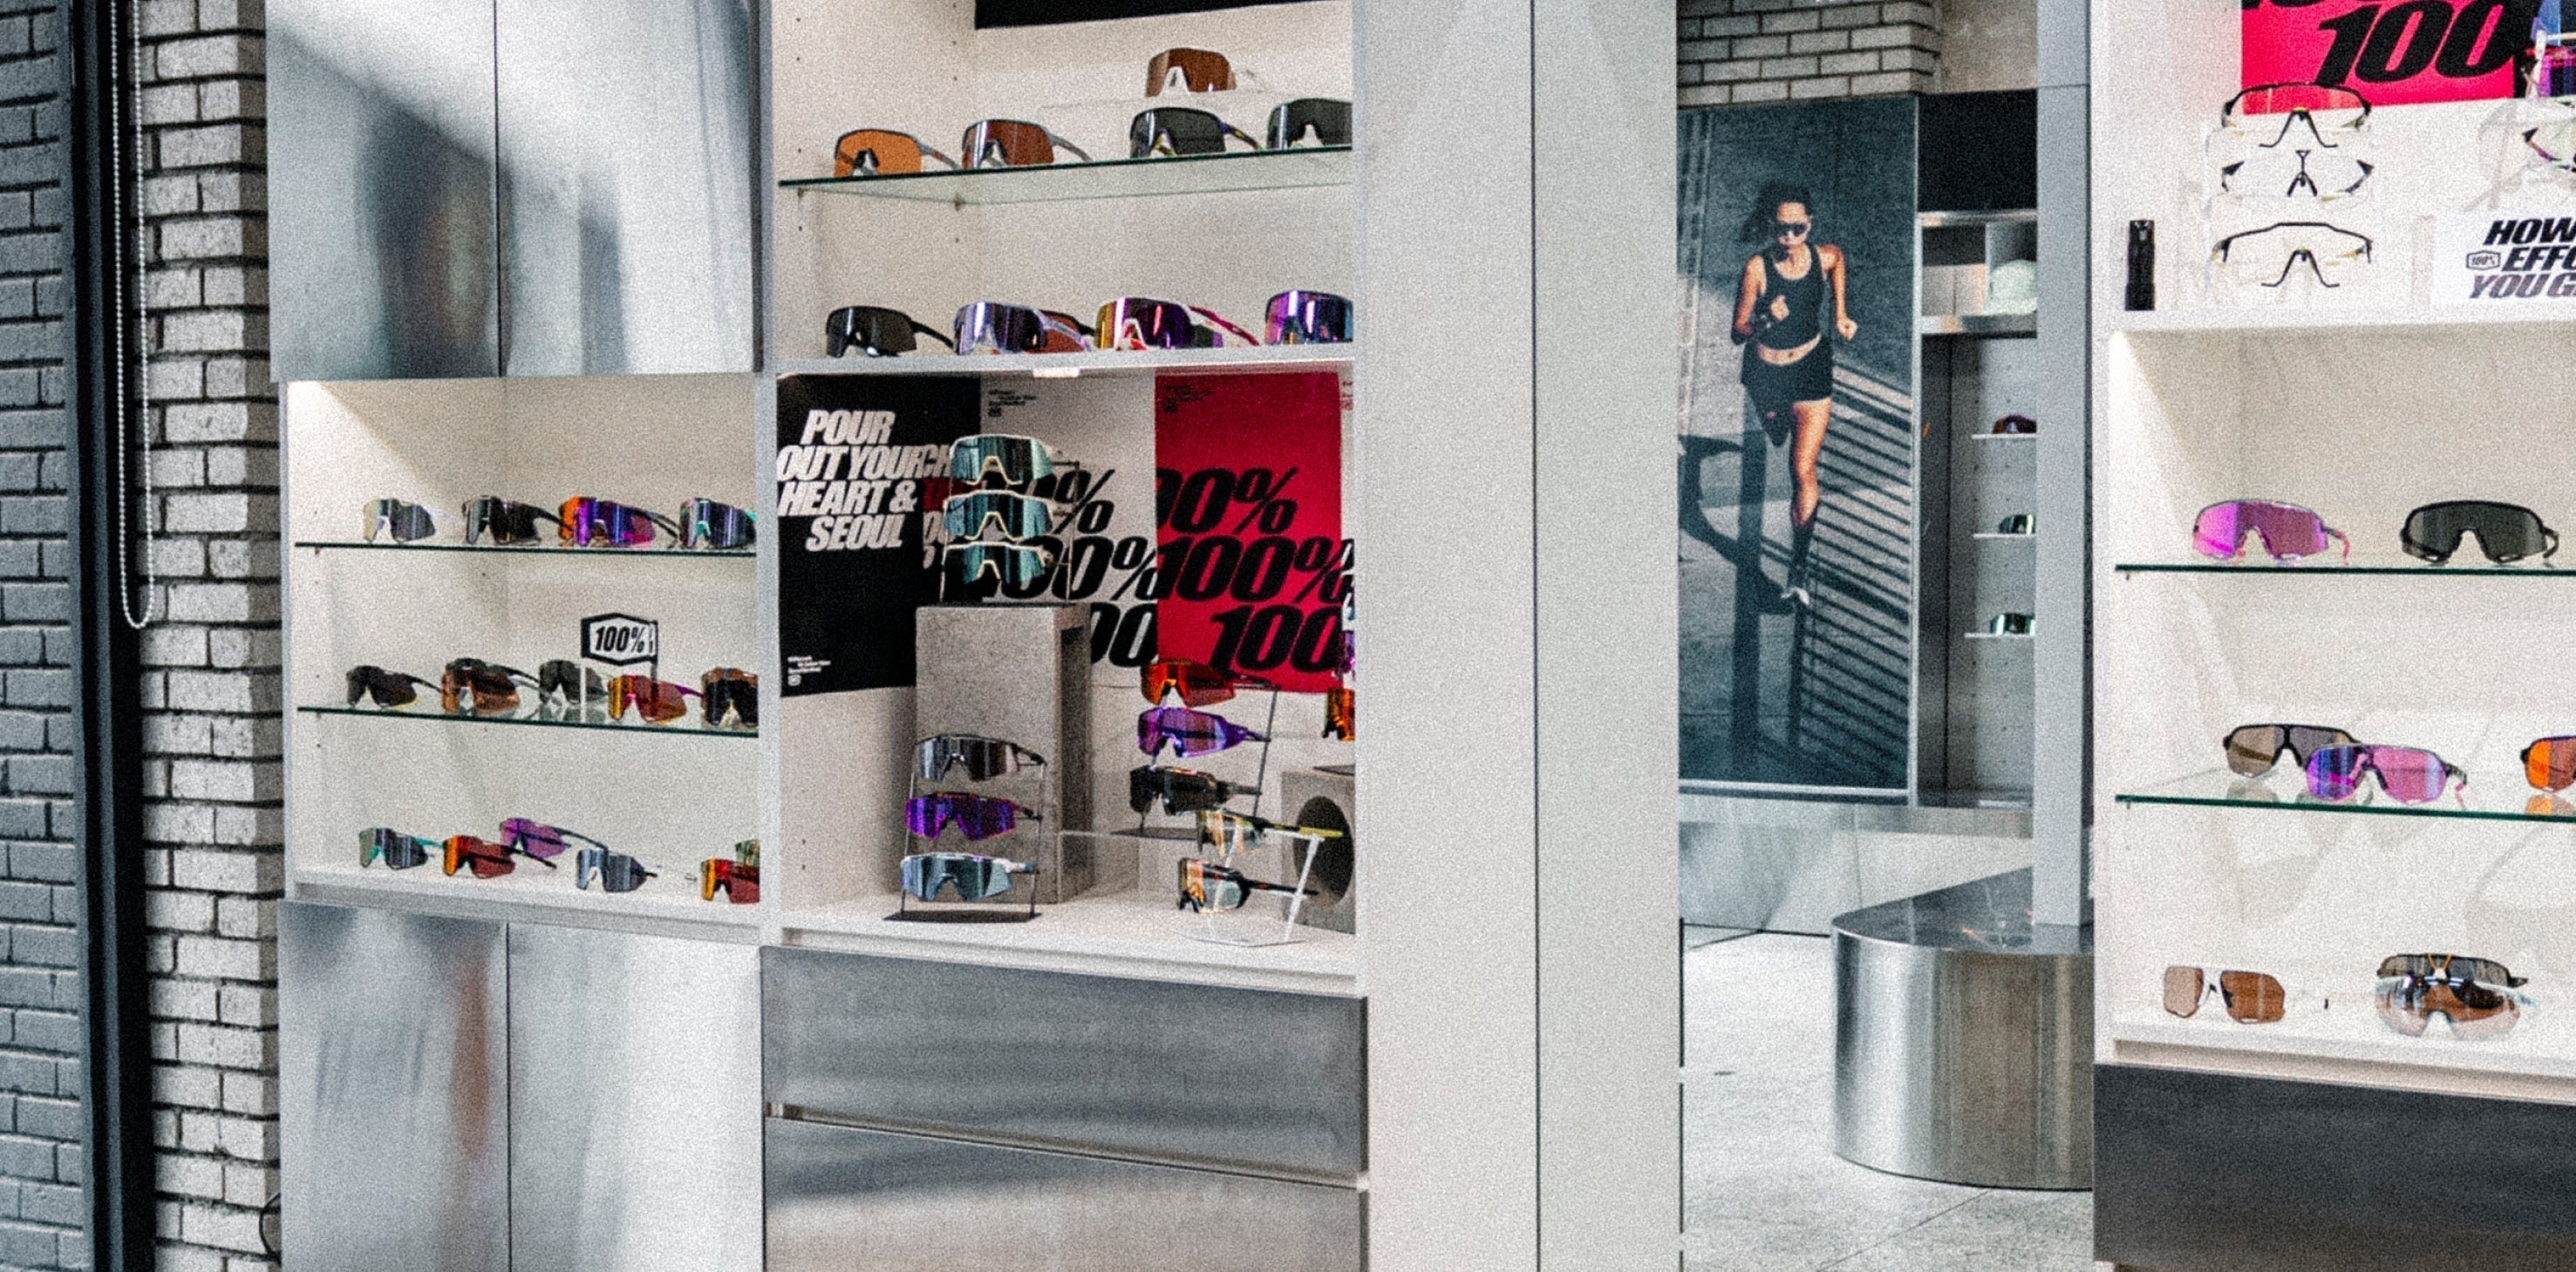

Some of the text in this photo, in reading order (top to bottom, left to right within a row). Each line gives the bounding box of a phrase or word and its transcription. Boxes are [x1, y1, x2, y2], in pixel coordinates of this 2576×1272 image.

[2483, 217, 2576, 245] HOW
[2470, 273, 2551, 298] YOU
[800, 409, 896, 446] POUR
[775, 445, 923, 480] OUT YOUR
[778, 480, 890, 516] HEART
[889, 480, 917, 513] &
[805, 514, 905, 552] SEOUL
[1157, 535, 1344, 603] 100%
[595, 625, 645, 653] 100%
